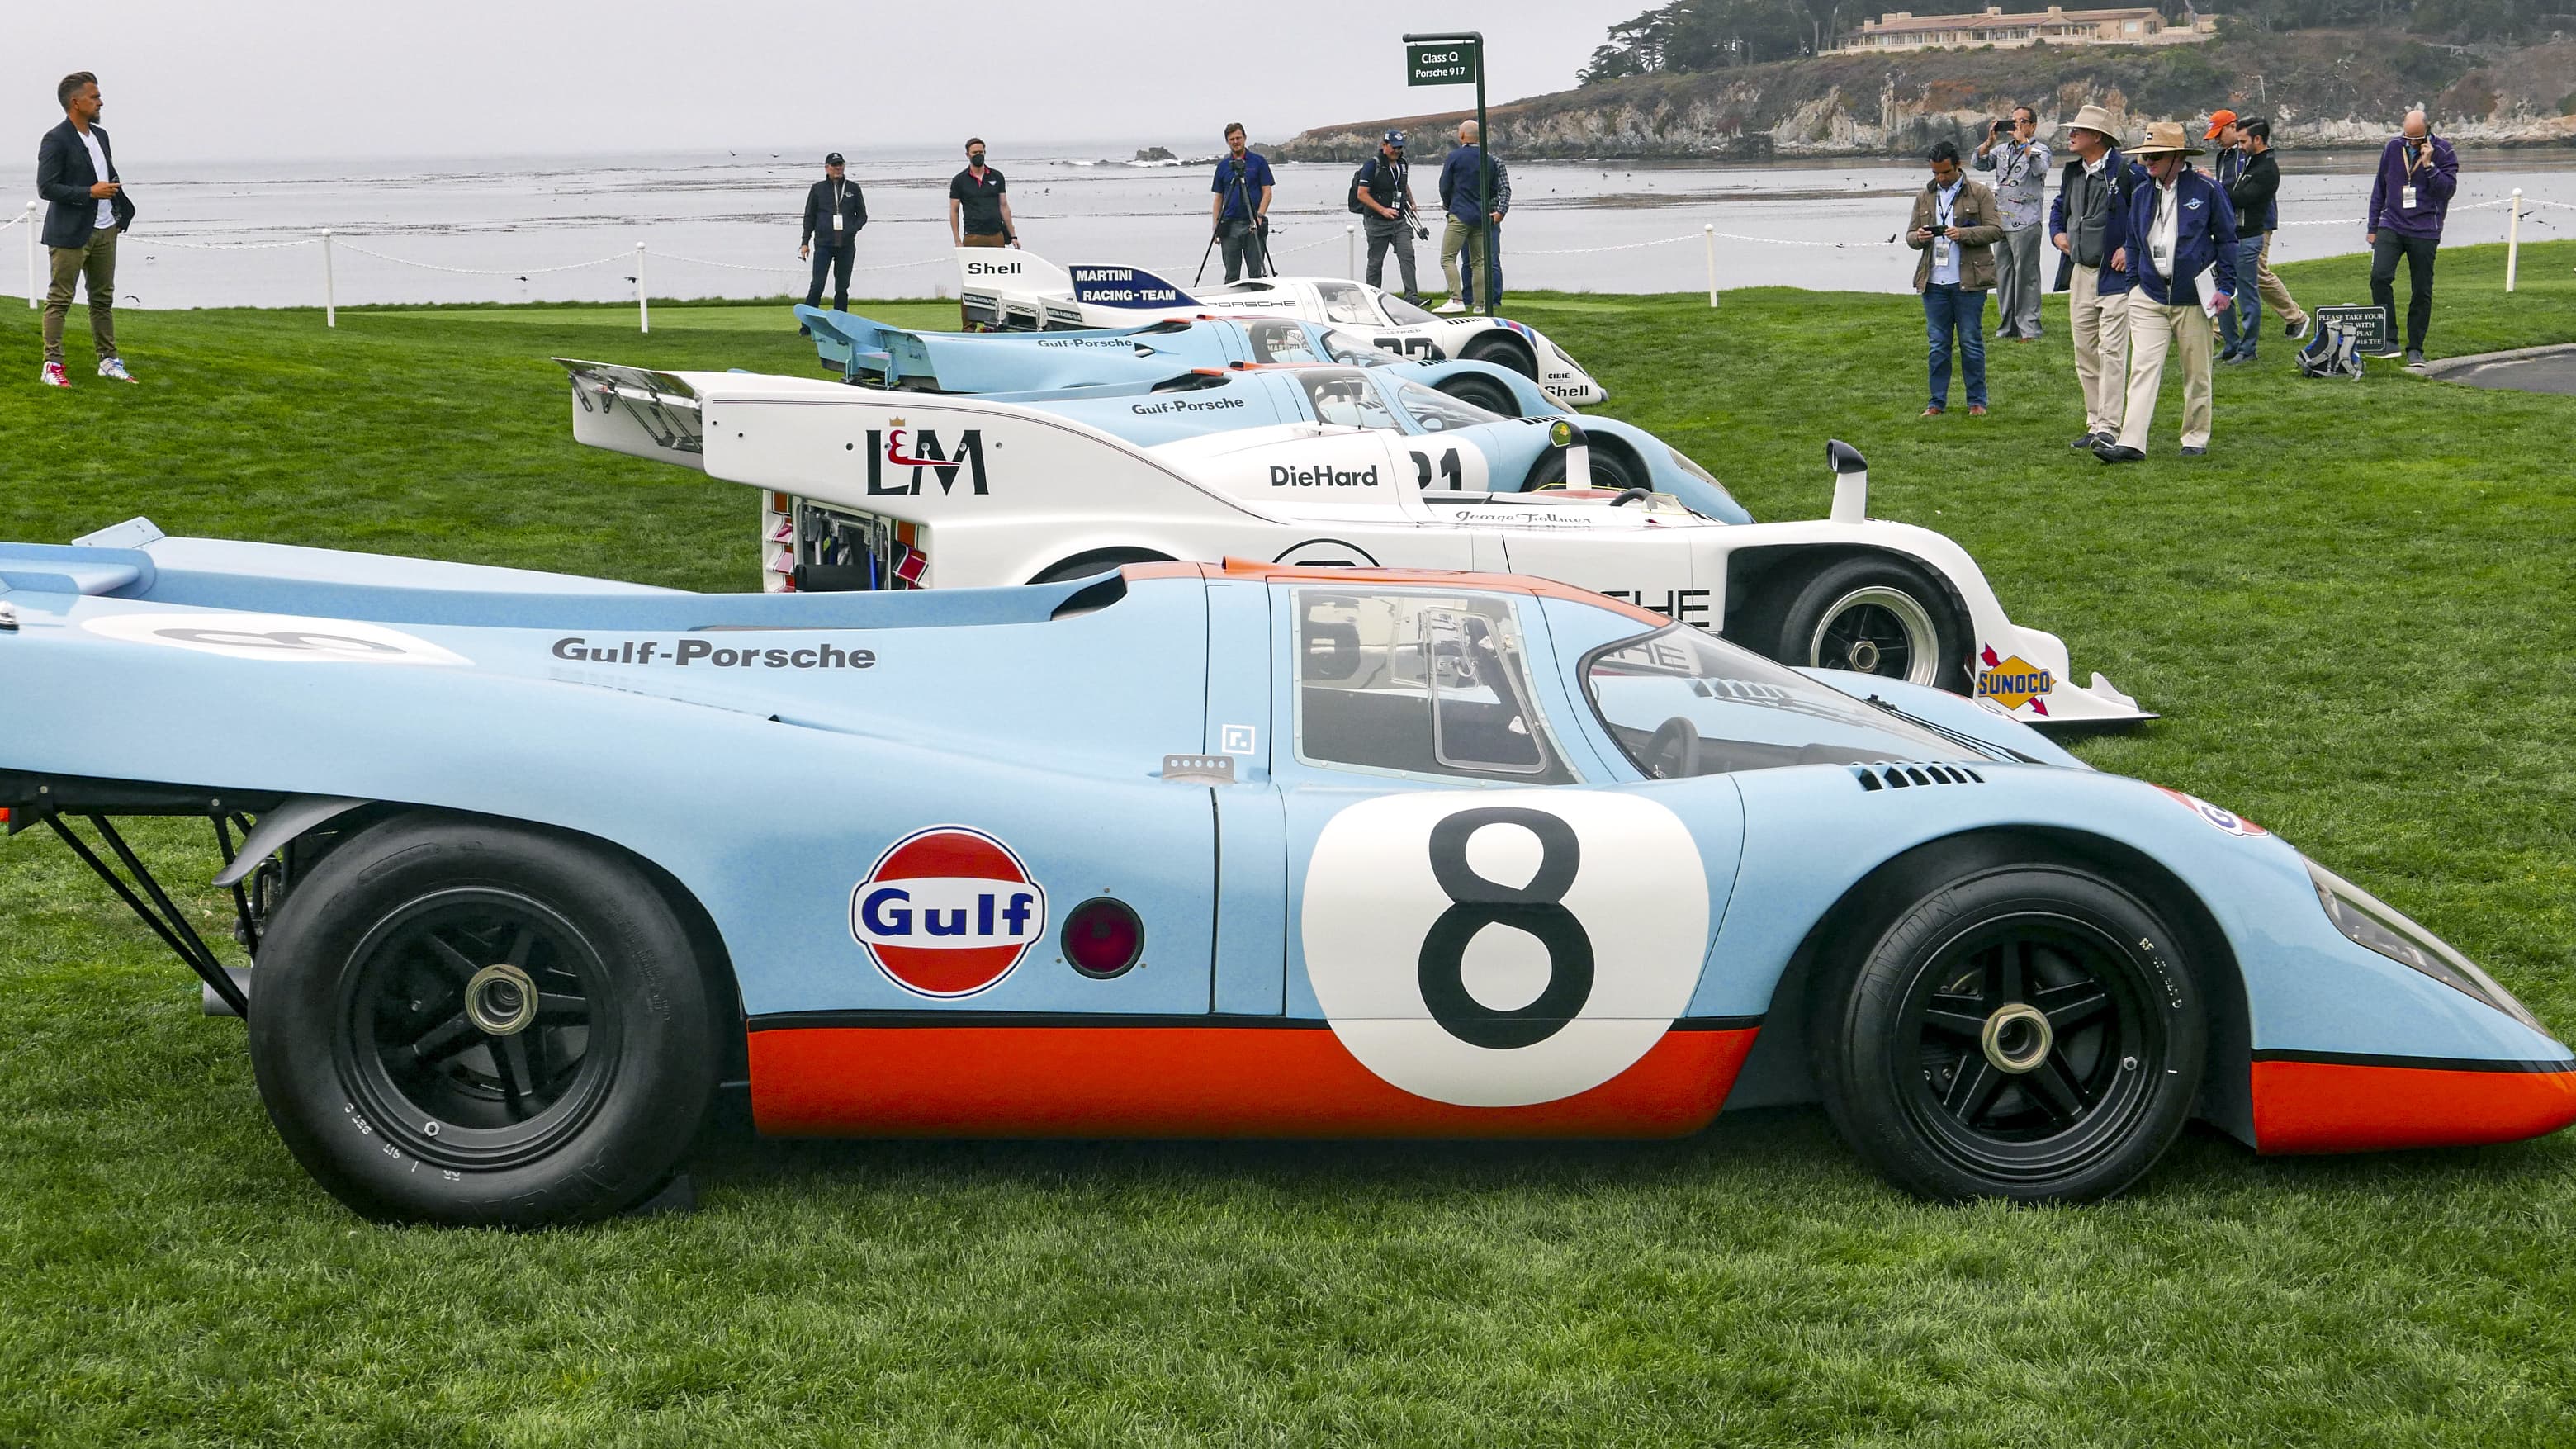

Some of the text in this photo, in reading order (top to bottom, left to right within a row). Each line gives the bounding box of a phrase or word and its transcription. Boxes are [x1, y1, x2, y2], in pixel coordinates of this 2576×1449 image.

[1421, 51, 1459, 64] Class Q
[1415, 66, 1466, 78] Porsche 917
[968, 263, 1021, 274] Shell
[1077, 269, 1132, 282] MARTINI
[1082, 289, 1176, 301] RACING-TEAM
[1037, 339, 1132, 348] Gulf-Porsche
[1544, 385, 1589, 397] Shell
[1132, 397, 1245, 415] Gulf-Porsche
[1270, 464, 1378, 486] DieHard
[552, 637, 876, 669] Gulf-Porsche
[1978, 671, 2050, 694] SUNOCO
[861, 888, 1034, 936] Gulf
[1418, 807, 1595, 1050] 8
[382, 1144, 400, 1159] 917
